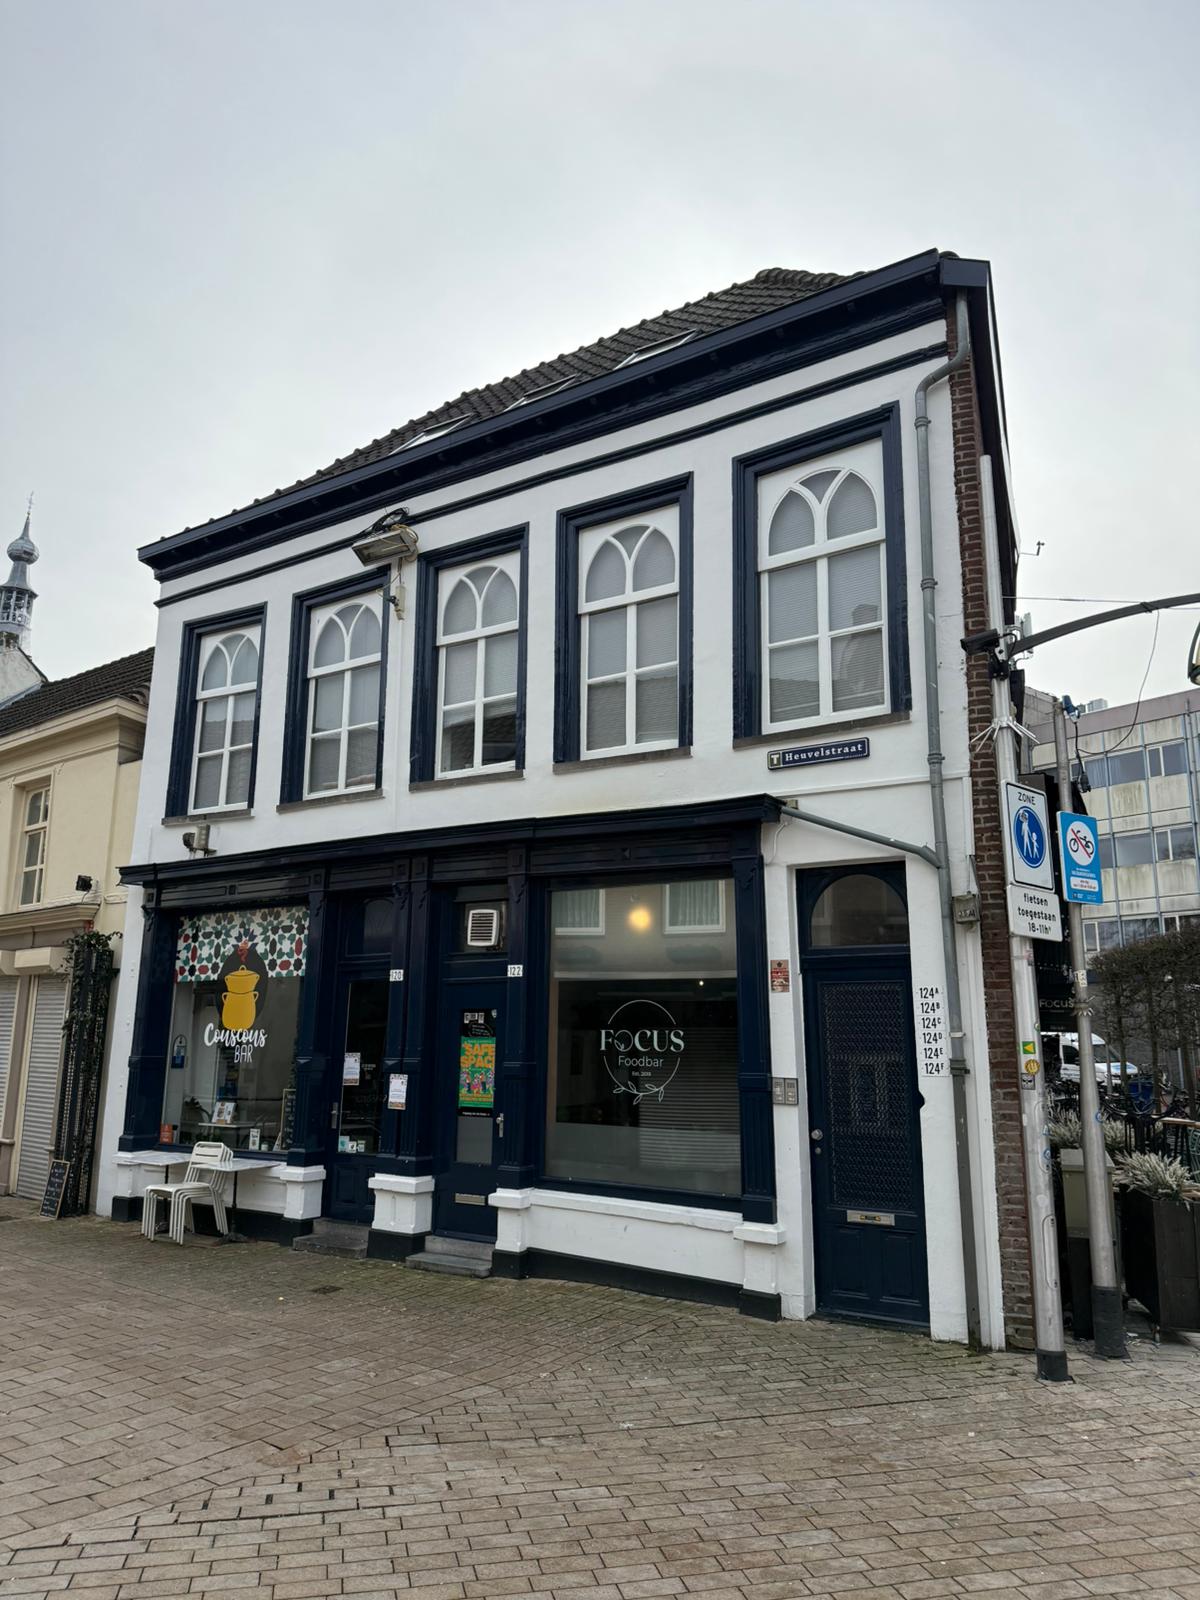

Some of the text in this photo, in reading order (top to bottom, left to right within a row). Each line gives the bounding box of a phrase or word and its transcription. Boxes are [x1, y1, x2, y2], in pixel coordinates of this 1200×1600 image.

[785, 743, 863, 762] Heuvelstraat
[1017, 791, 1036, 806] ZONE
[1023, 892, 1049, 907] fietsen
[1017, 906, 1057, 921] toegestaan
[391, 971, 403, 981] 120
[509, 966, 521, 976] 122
[919, 987, 939, 999] 124A
[920, 1002, 941, 1014] 124B
[1039, 999, 1074, 1009] FOCUS
[921, 1017, 942, 1029] 124C
[203, 1022, 268, 1048] Couscous
[599, 1029, 685, 1053] FOCUS
[922, 1032, 943, 1044] 124D
[233, 1044, 254, 1063] BAR
[464, 1043, 496, 1057] SAFE
[923, 1047, 944, 1059] 124E
[618, 1055, 664, 1067] Foodbar
[924, 1062, 945, 1075] 124F
